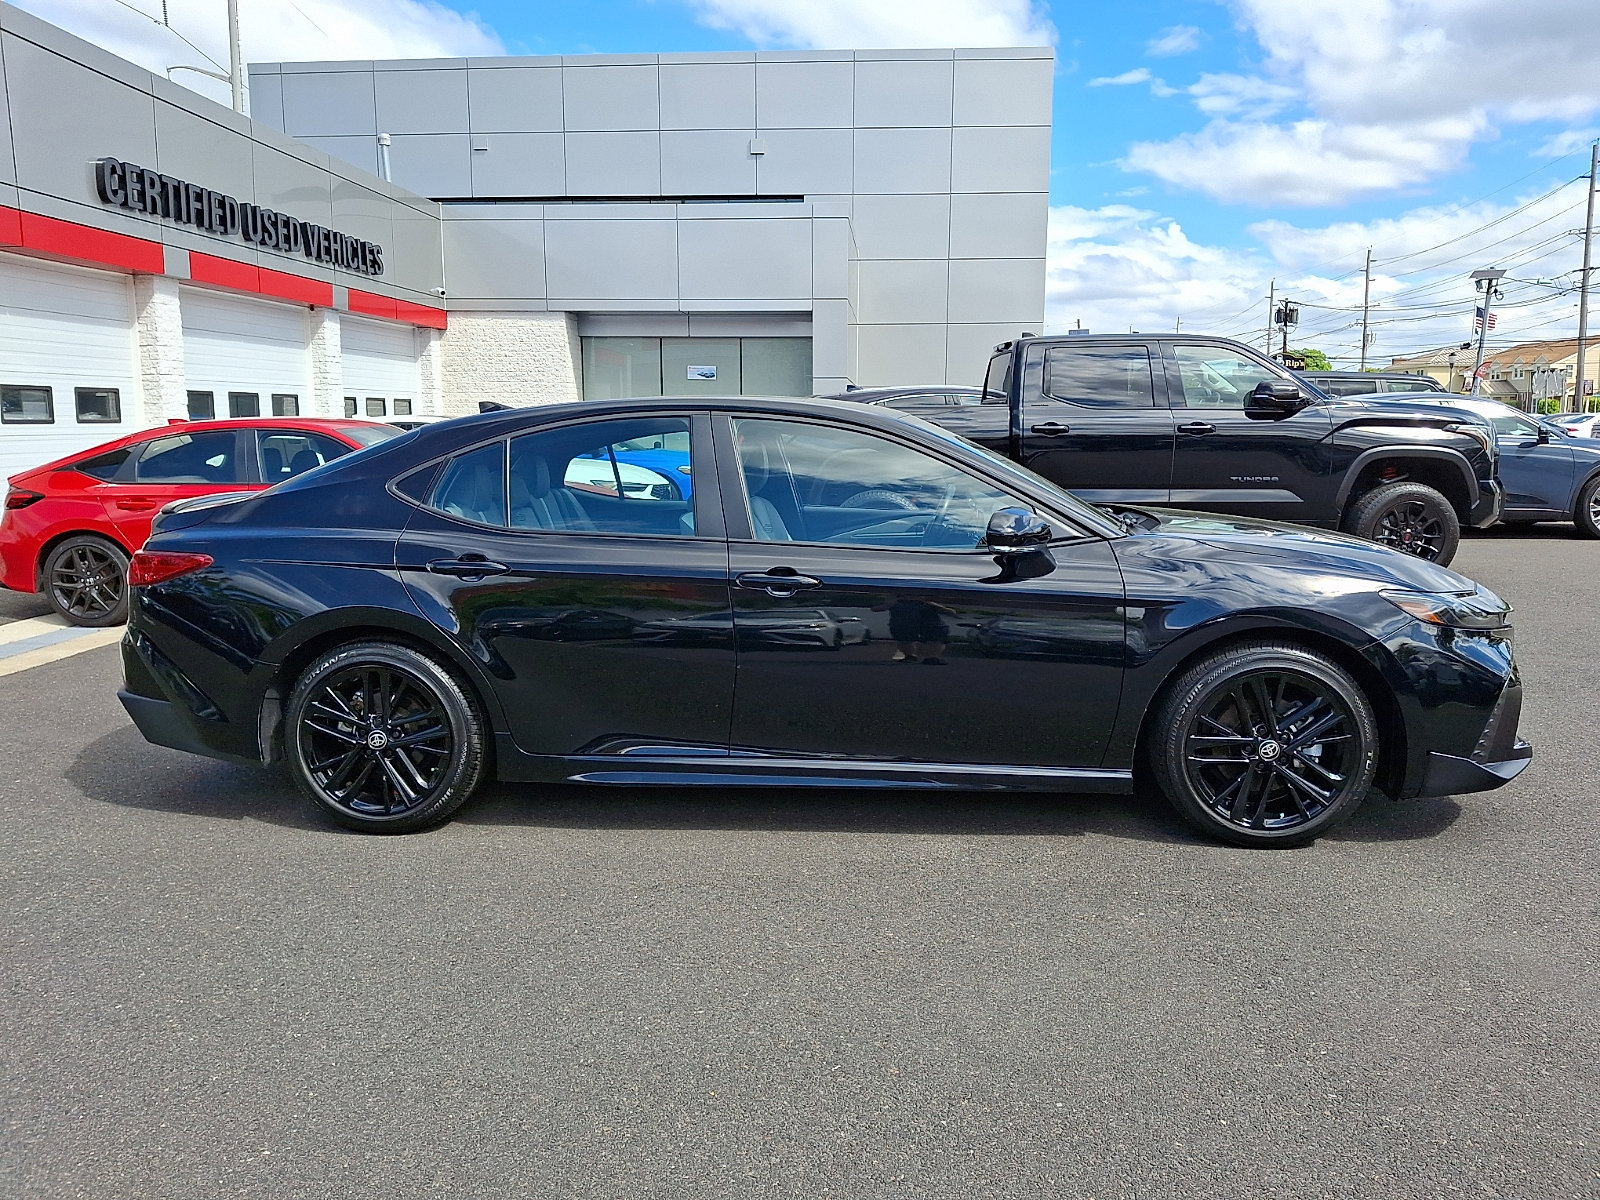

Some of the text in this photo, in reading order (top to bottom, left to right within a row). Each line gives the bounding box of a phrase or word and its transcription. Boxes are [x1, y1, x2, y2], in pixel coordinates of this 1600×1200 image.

[97, 157, 384, 275] CERTIFIED USED VEHICLES
[1230, 475, 1279, 483] TUNDRA
